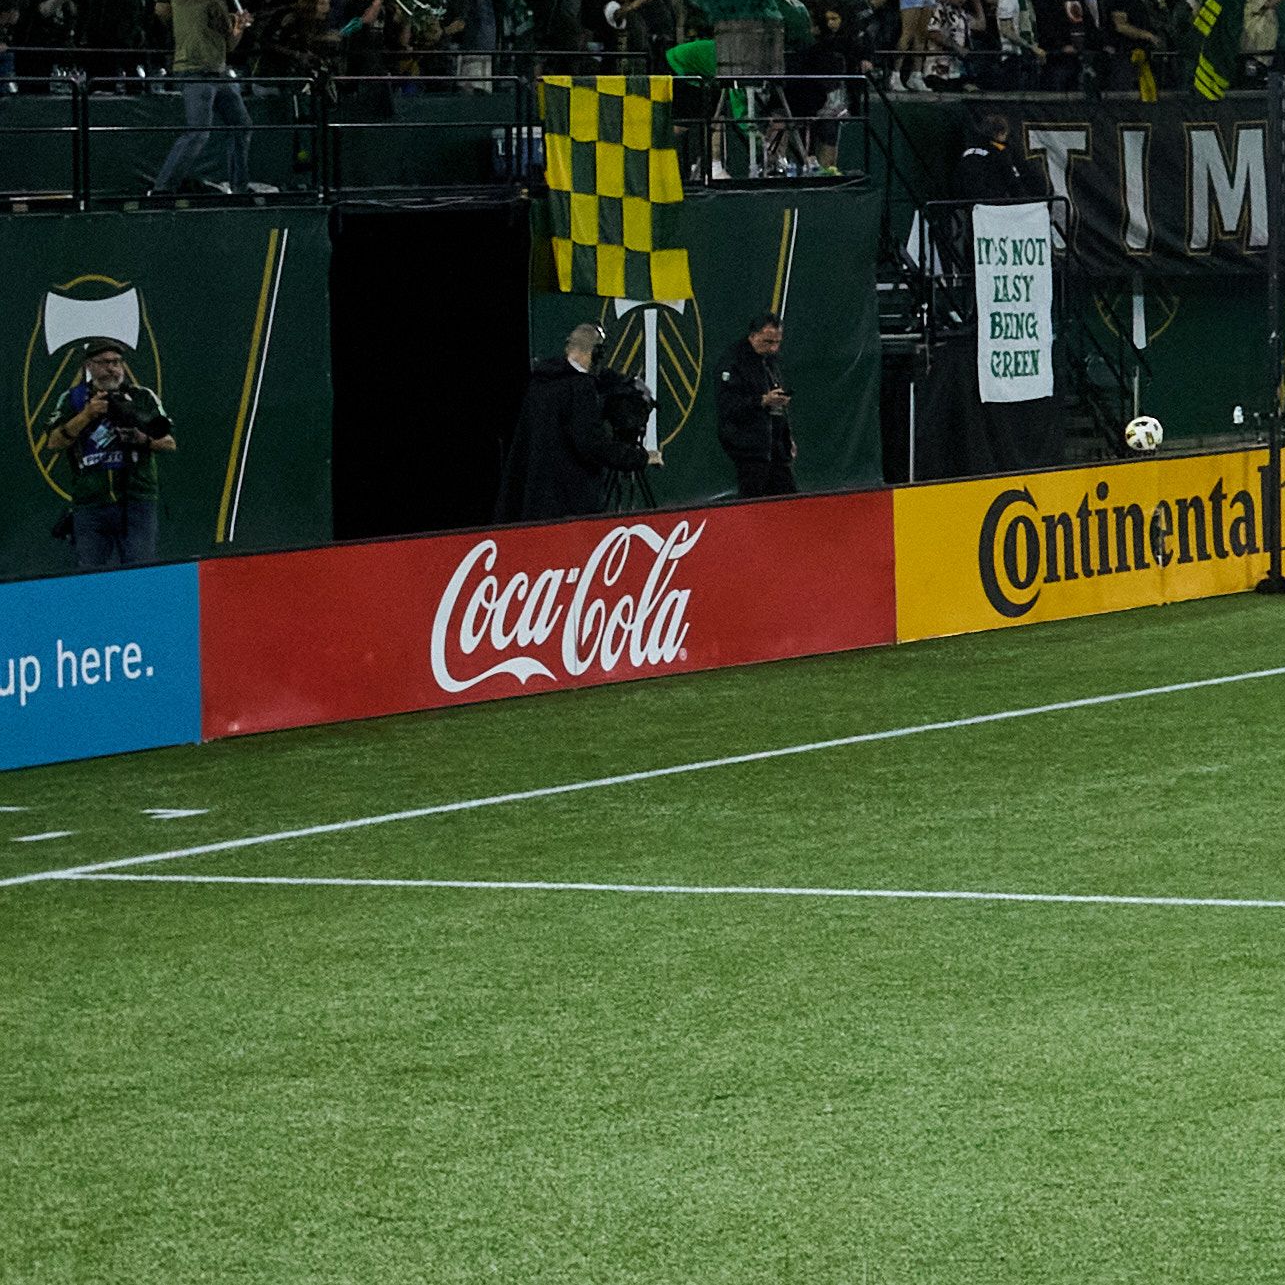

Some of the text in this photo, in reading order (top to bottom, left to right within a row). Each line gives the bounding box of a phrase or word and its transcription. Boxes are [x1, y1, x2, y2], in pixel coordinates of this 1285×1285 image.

[1011, 237, 1046, 266] NOT
[993, 272, 1034, 303] EASY
[989, 311, 1039, 340] BEING
[990, 349, 1041, 379] GREEN
[978, 465, 1275, 618] Continental
[430, 518, 707, 693] Coca-Cola
[0, 638, 154, 707] up here.
